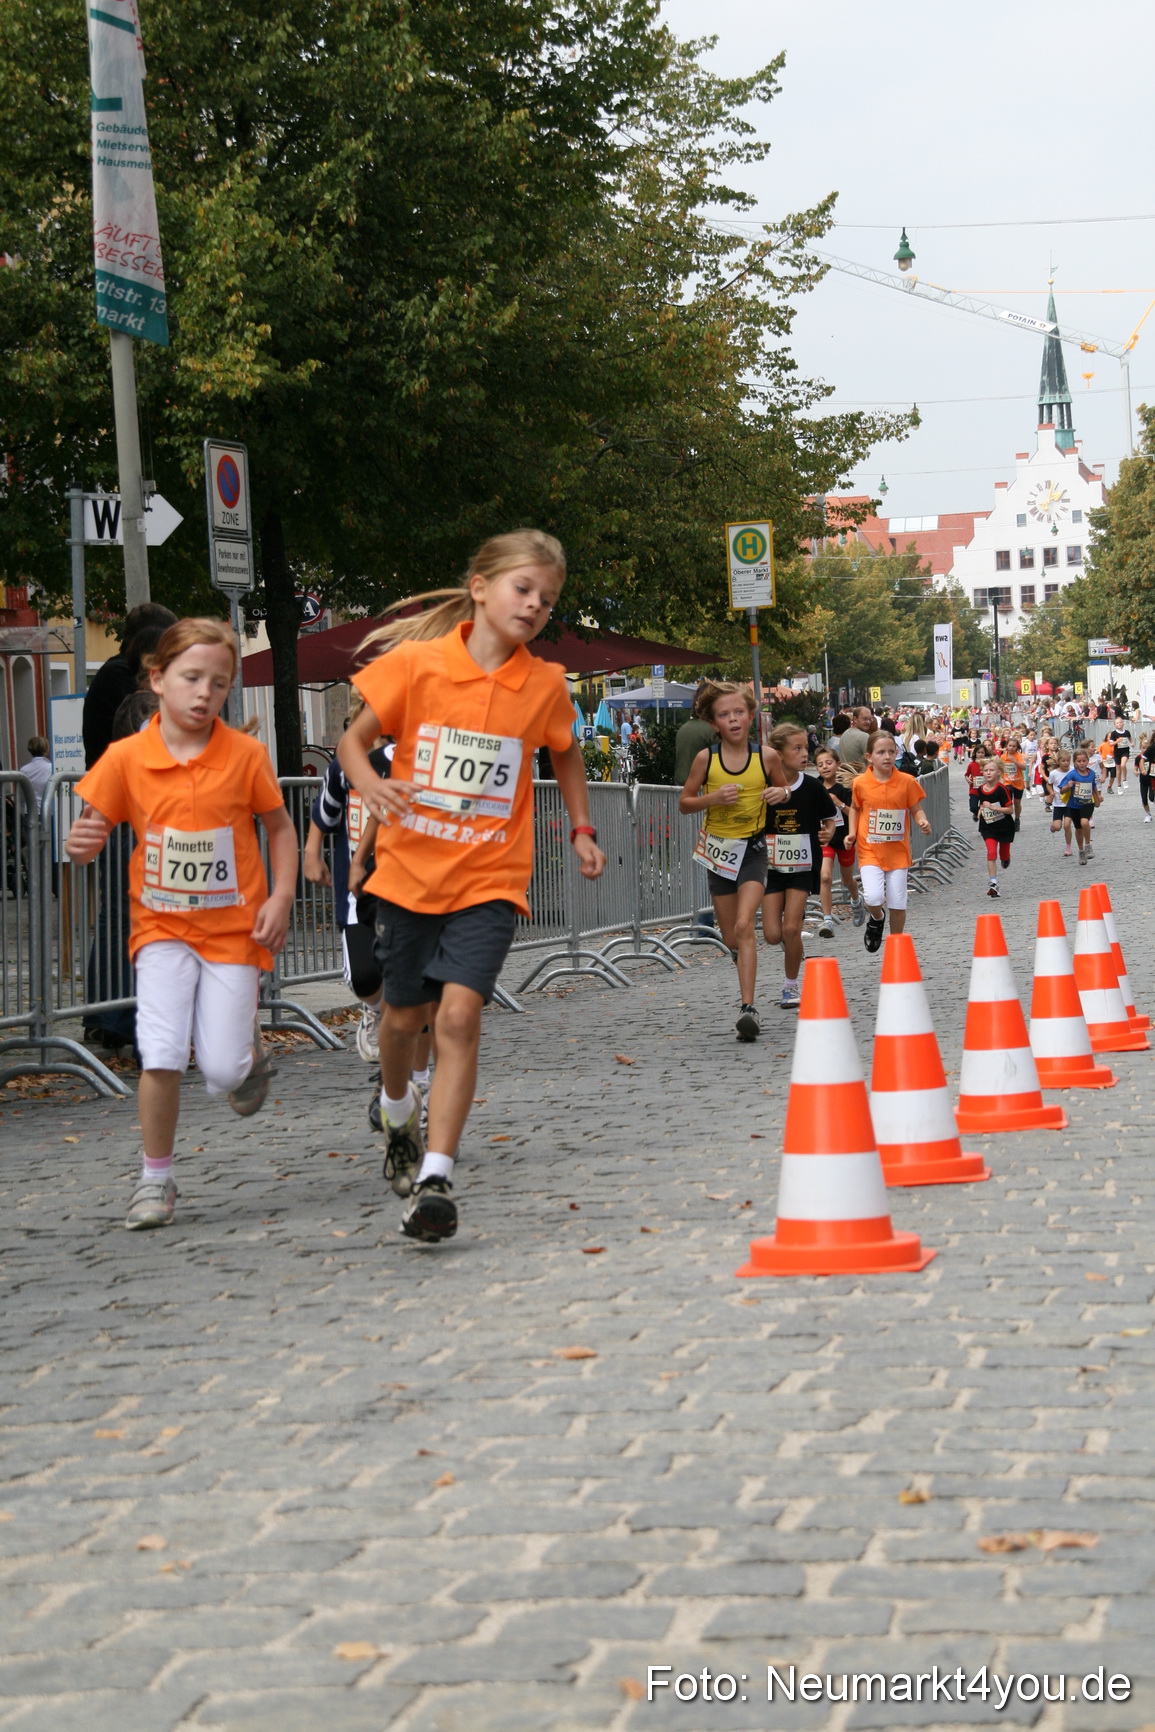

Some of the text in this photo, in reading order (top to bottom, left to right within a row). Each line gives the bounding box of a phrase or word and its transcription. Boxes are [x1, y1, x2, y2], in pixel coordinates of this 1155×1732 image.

[150, 297, 167, 314] 13
[1007, 313, 1037, 326] POTAIN
[92, 500, 121, 539] W
[222, 511, 240, 526] ZONE
[218, 549, 232, 560] Parken
[1023, 683, 1029, 692] D
[1076, 685, 1081, 693] C
[872, 691, 879, 699] D
[446, 728, 502, 751] Theresa
[418, 748, 431, 762] K3
[444, 755, 510, 786] 7075
[350, 813, 359, 823] K3
[879, 821, 902, 831] 7079
[167, 836, 214, 853] Annette
[777, 837, 791, 846] Nina
[147, 852, 158, 865] K3
[707, 842, 738, 865] 7052
[778, 848, 808, 860] 7093
[168, 860, 228, 882] 7078
